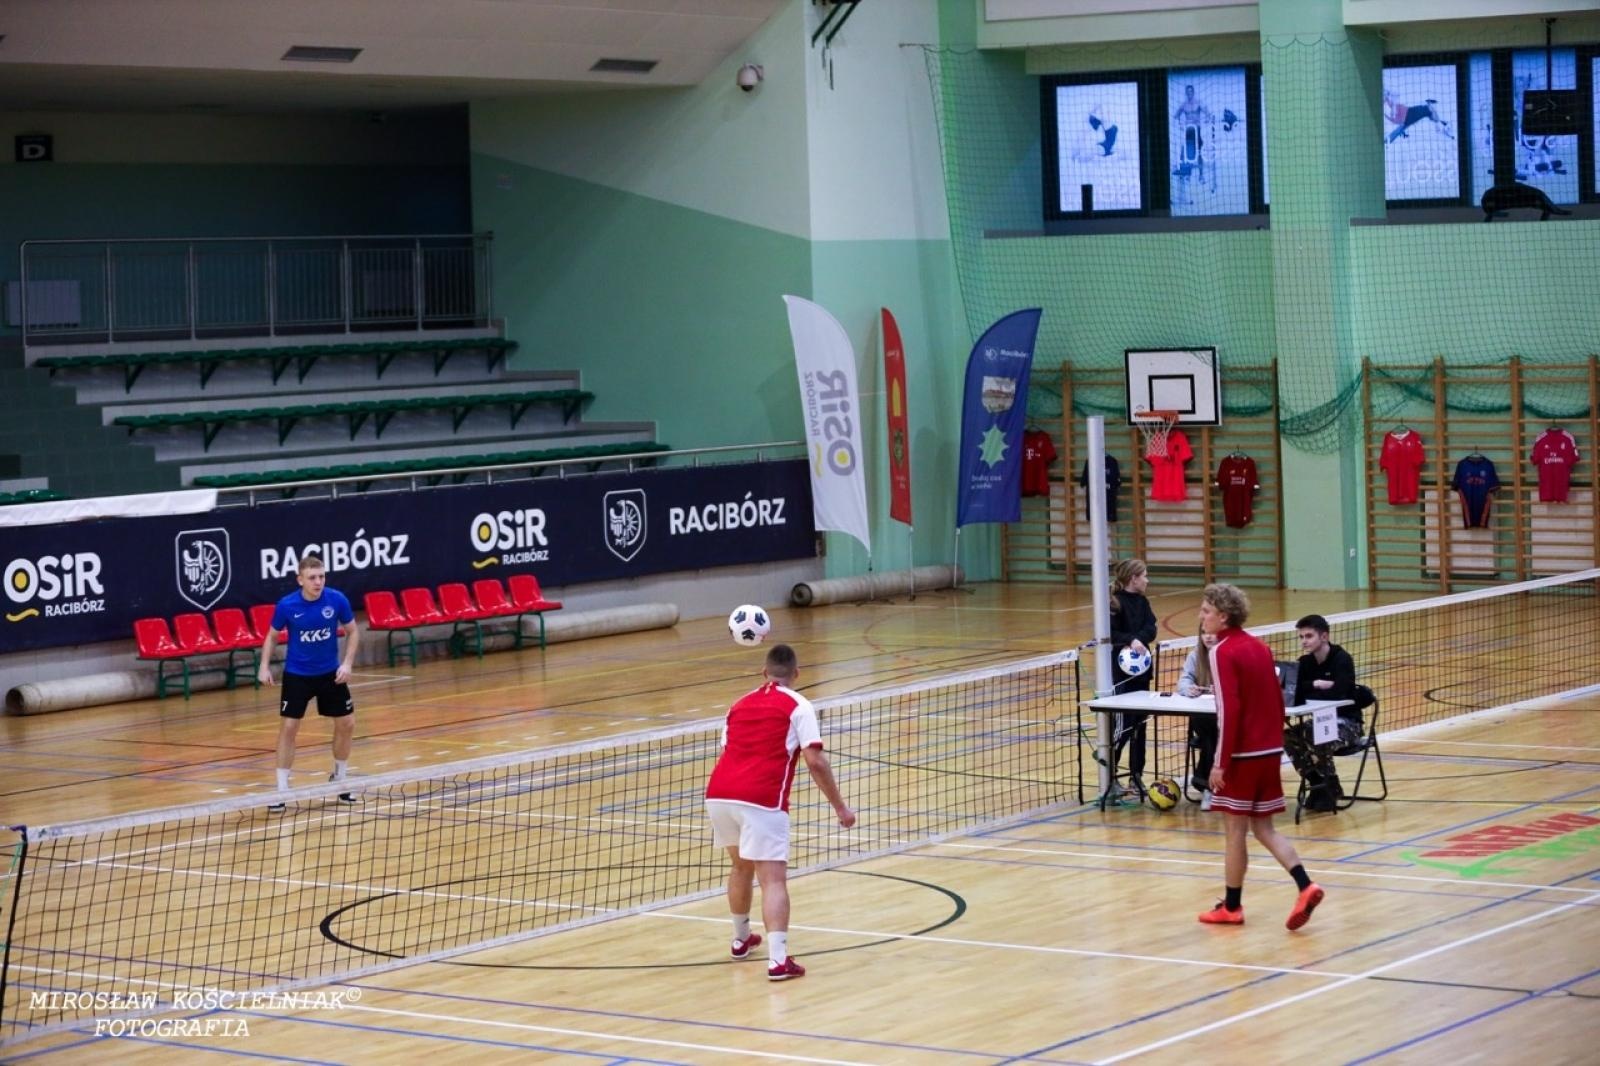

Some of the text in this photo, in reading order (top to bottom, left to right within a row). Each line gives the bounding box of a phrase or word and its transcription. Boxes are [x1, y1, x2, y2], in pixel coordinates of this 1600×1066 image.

[22, 144, 46, 159] D
[670, 491, 786, 536] RACIBÓRZ
[470, 508, 549, 553] OSiR
[502, 548, 549, 566] RACIBÓRZ
[4, 552, 104, 604] OSiR
[45, 597, 105, 618] RACIBÓRZ
[300, 627, 332, 643] KKS
[281, 701, 288, 712] 7
